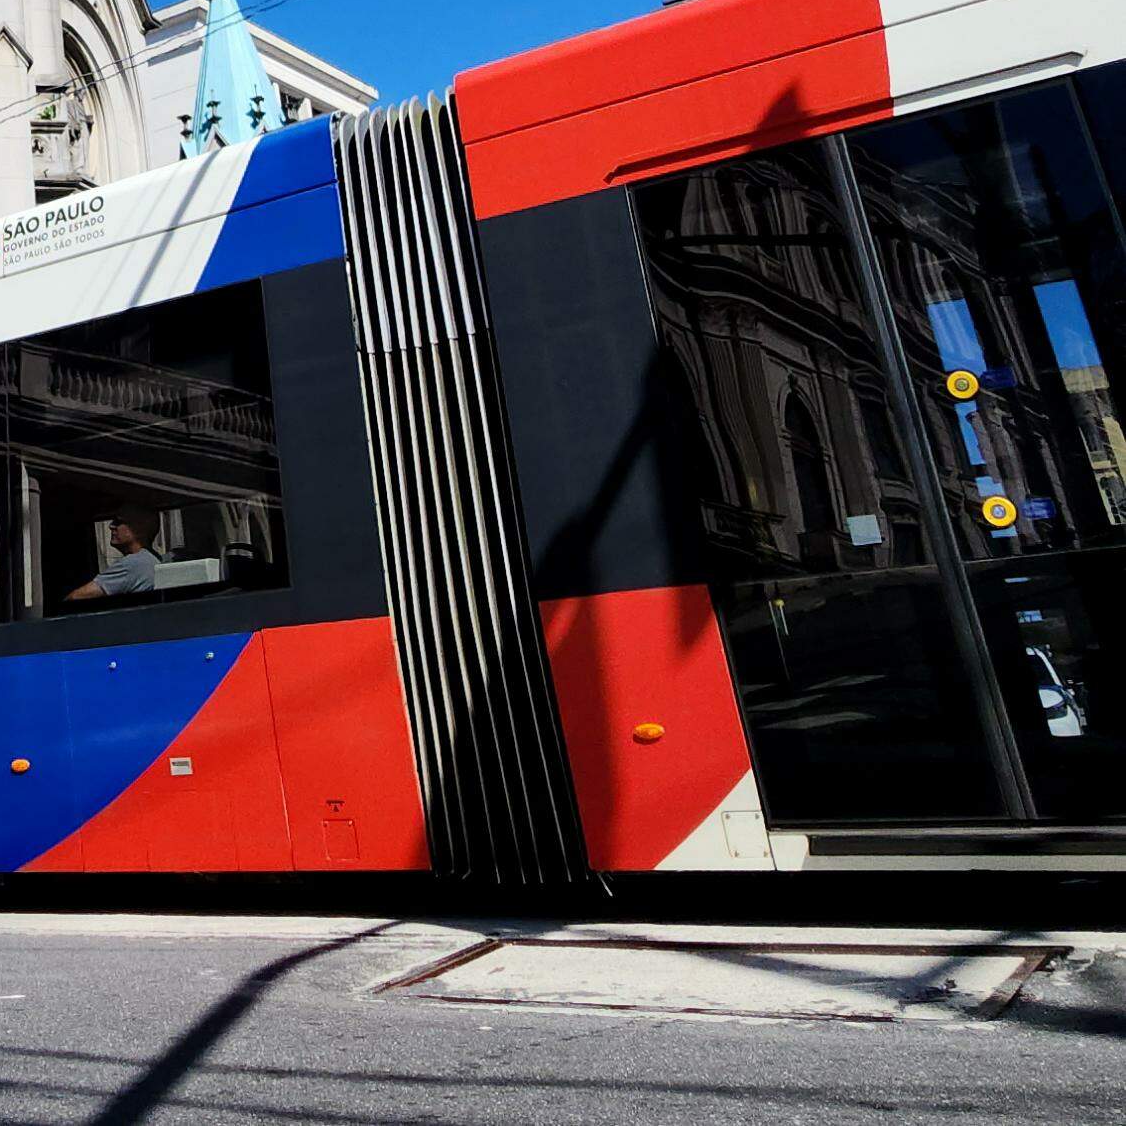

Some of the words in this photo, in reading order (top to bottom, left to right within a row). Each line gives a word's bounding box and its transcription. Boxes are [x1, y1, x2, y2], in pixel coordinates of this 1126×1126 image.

[4, 217, 40, 241] SÃO
[45, 196, 104, 228] PAULO
[4, 233, 48, 253] GOVERNO
[52, 227, 65, 238] DO
[69, 215, 105, 233] ESTADO
[4, 253, 21, 267] SÃO
[25, 245, 51, 260] PAULO
[54, 237, 72, 251] SÃO
[75, 229, 105, 245] TODOS
